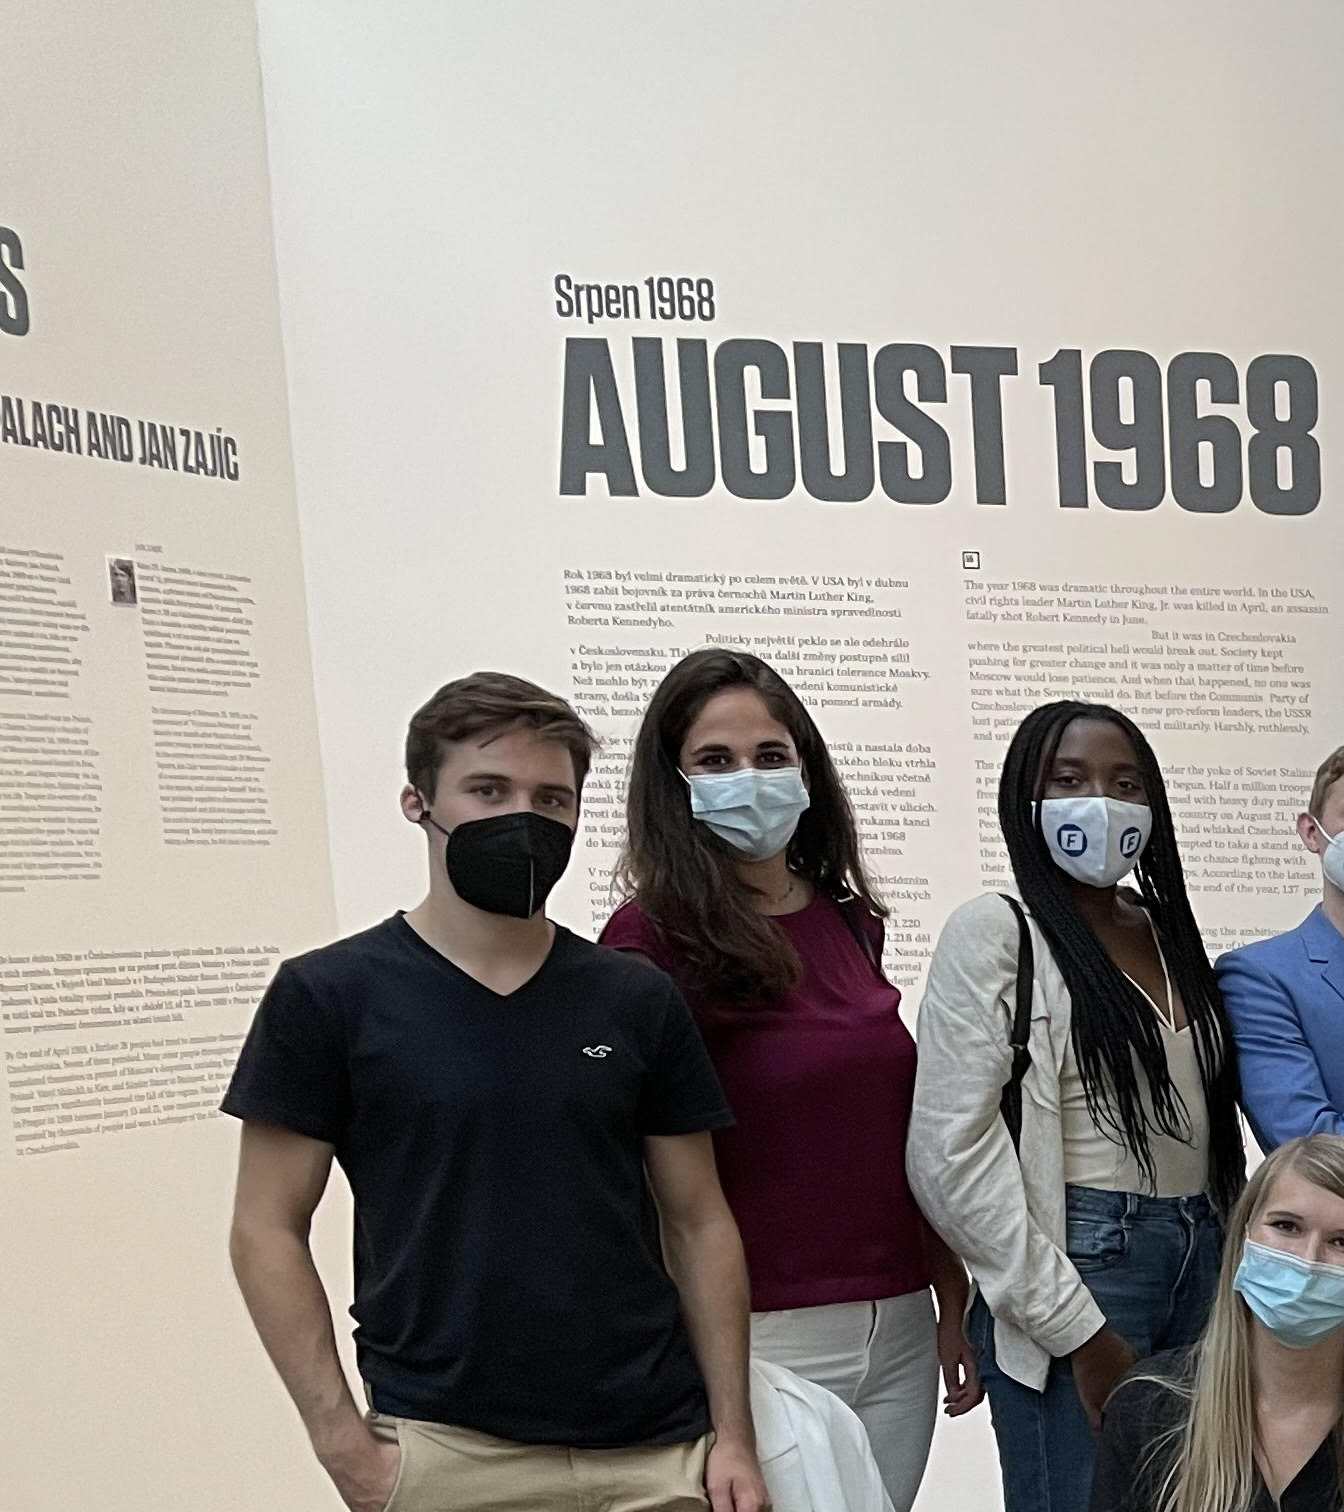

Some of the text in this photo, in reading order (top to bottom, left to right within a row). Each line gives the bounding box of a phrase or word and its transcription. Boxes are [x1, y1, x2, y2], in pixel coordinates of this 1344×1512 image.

[555, 274, 715, 324] Srpen 1968
[1, 396, 240, 482] ALACH AND JAN ZAJÍC
[559, 337, 1322, 516] AUGUST 1968
[1067, 834, 1077, 847] F
